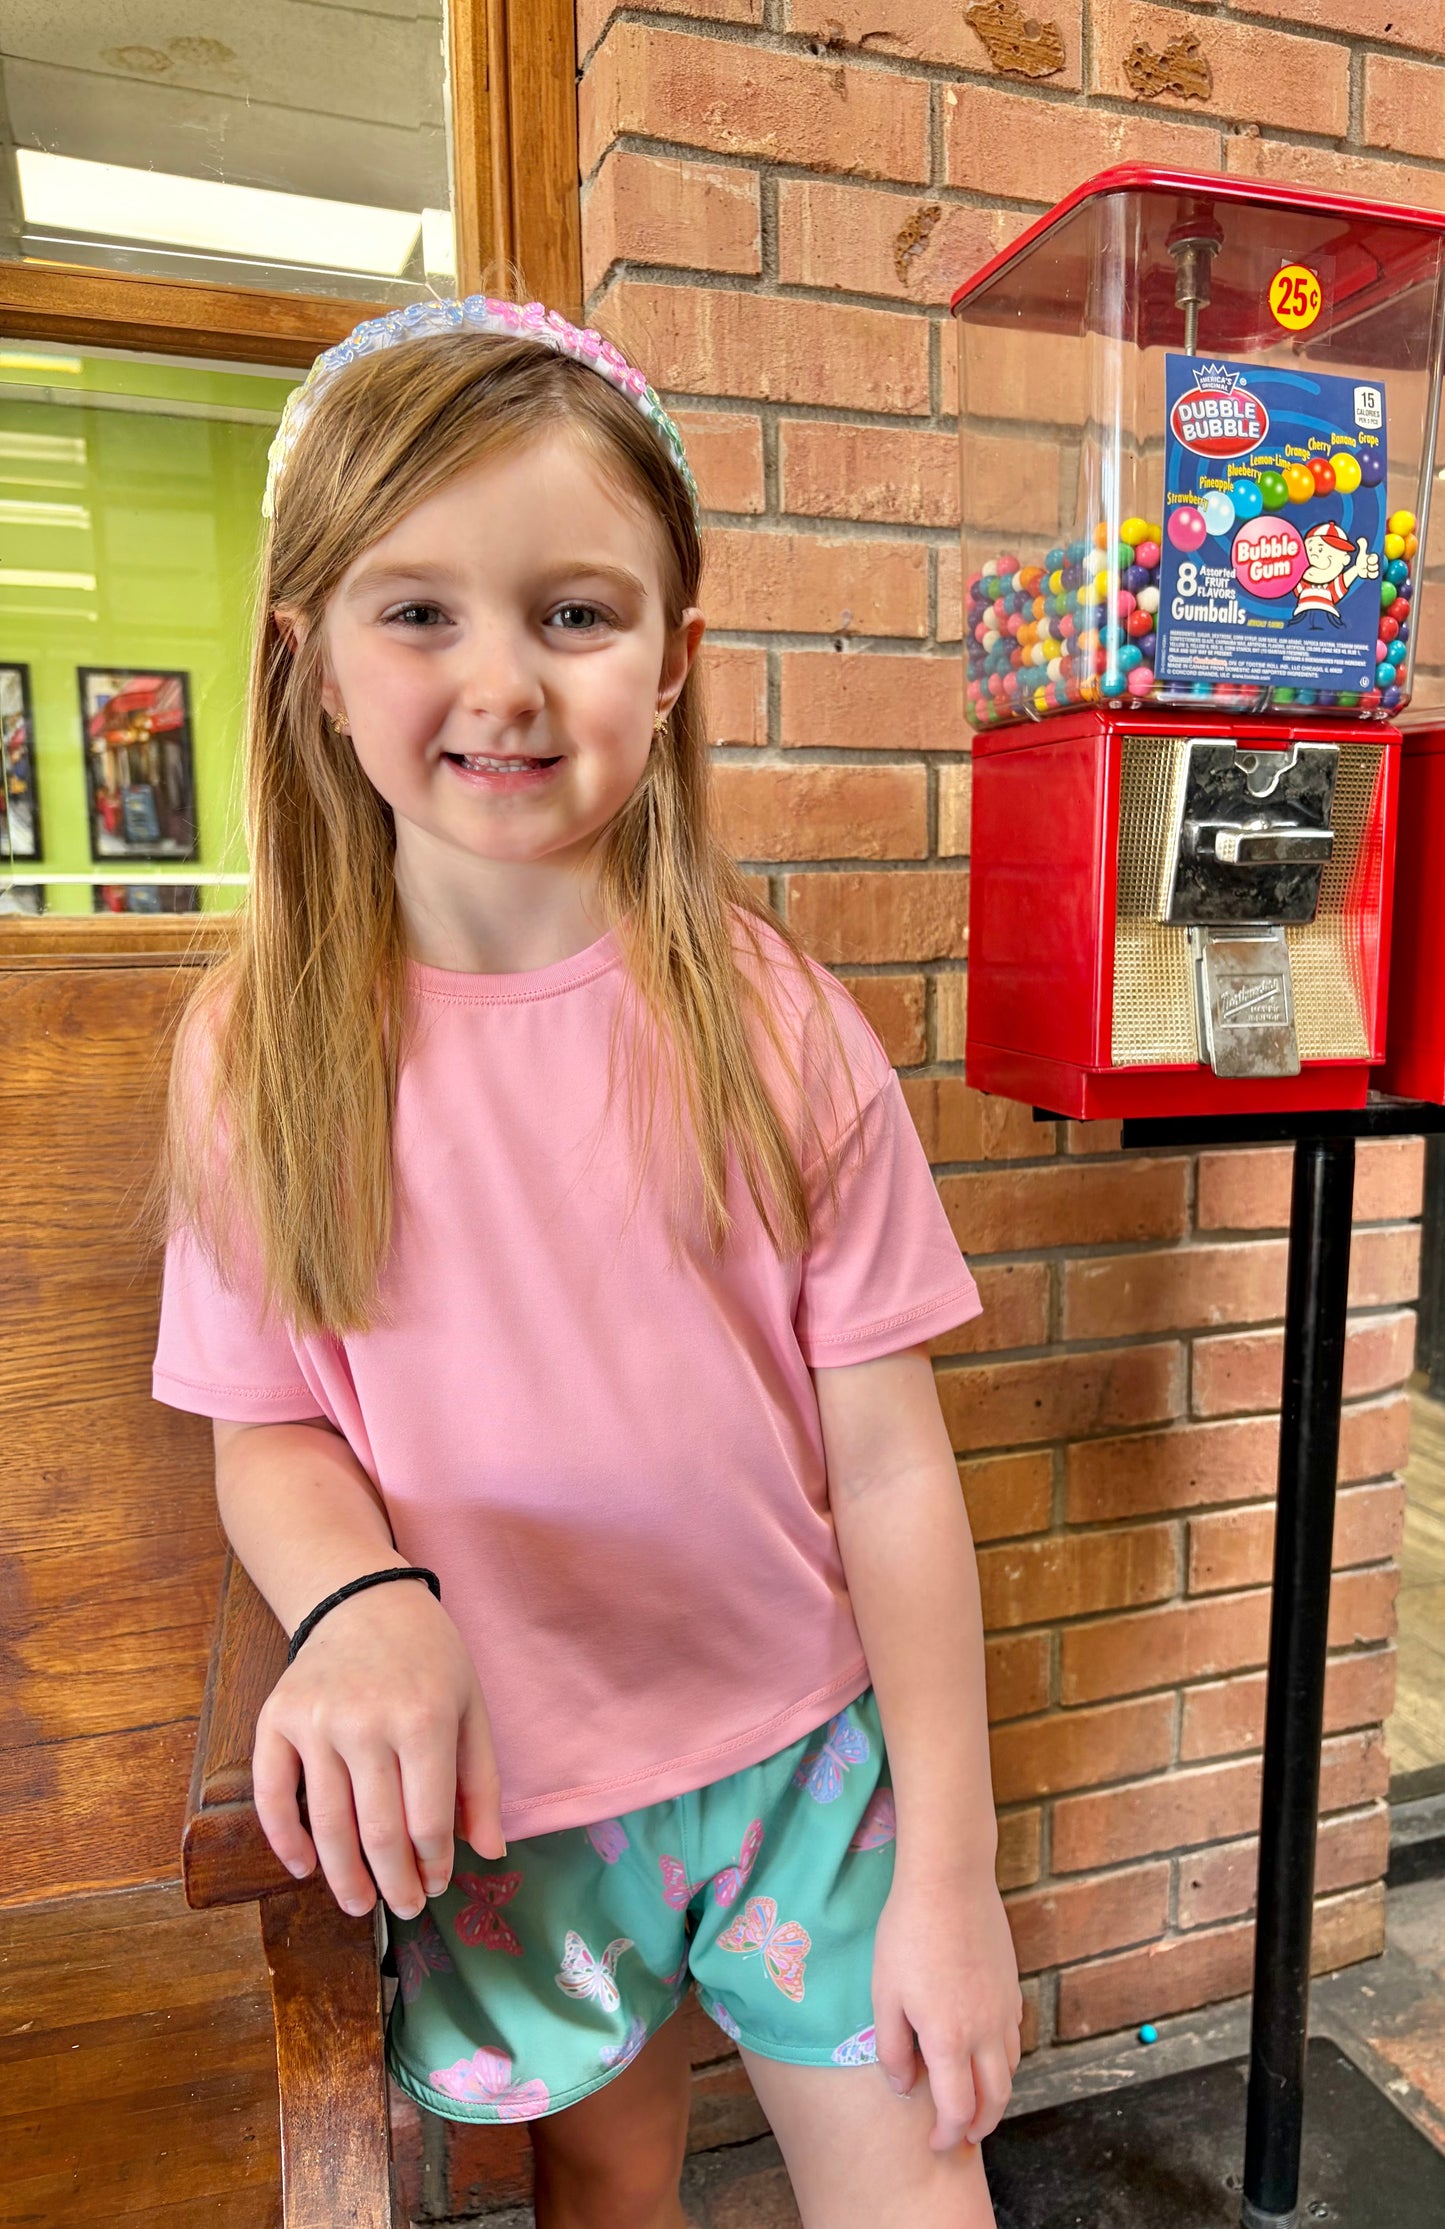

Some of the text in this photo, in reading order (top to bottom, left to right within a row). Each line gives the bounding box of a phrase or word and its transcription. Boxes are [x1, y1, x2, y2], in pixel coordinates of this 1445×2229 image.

[1277, 277, 1318, 316] 25¢
[1200, 376, 1232, 386] AMERICA'S
[1361, 392, 1375, 408] 15
[1178, 400, 1256, 421] DUBBLE
[1356, 408, 1380, 418] CALORIES
[1182, 419, 1260, 441] BUBBLE
[1308, 437, 1331, 456] Cherry
[1331, 432, 1356, 448] Banana
[1358, 431, 1379, 448] Grape
[1285, 444, 1310, 461] Orange
[1250, 454, 1291, 470] Lemon-Lime
[1227, 462, 1262, 483] Blueberry
[1199, 476, 1234, 493] Pineapple
[1167, 490, 1208, 512] Strawberry
[1237, 535, 1298, 563] Bubble
[1177, 562, 1198, 597] 8
[1200, 565, 1236, 579] Assorted
[1250, 561, 1290, 581] Gum
[1205, 577, 1230, 589] FRUIT
[1197, 586, 1236, 600] FLAVORS
[1171, 597, 1246, 625] Gumballs
